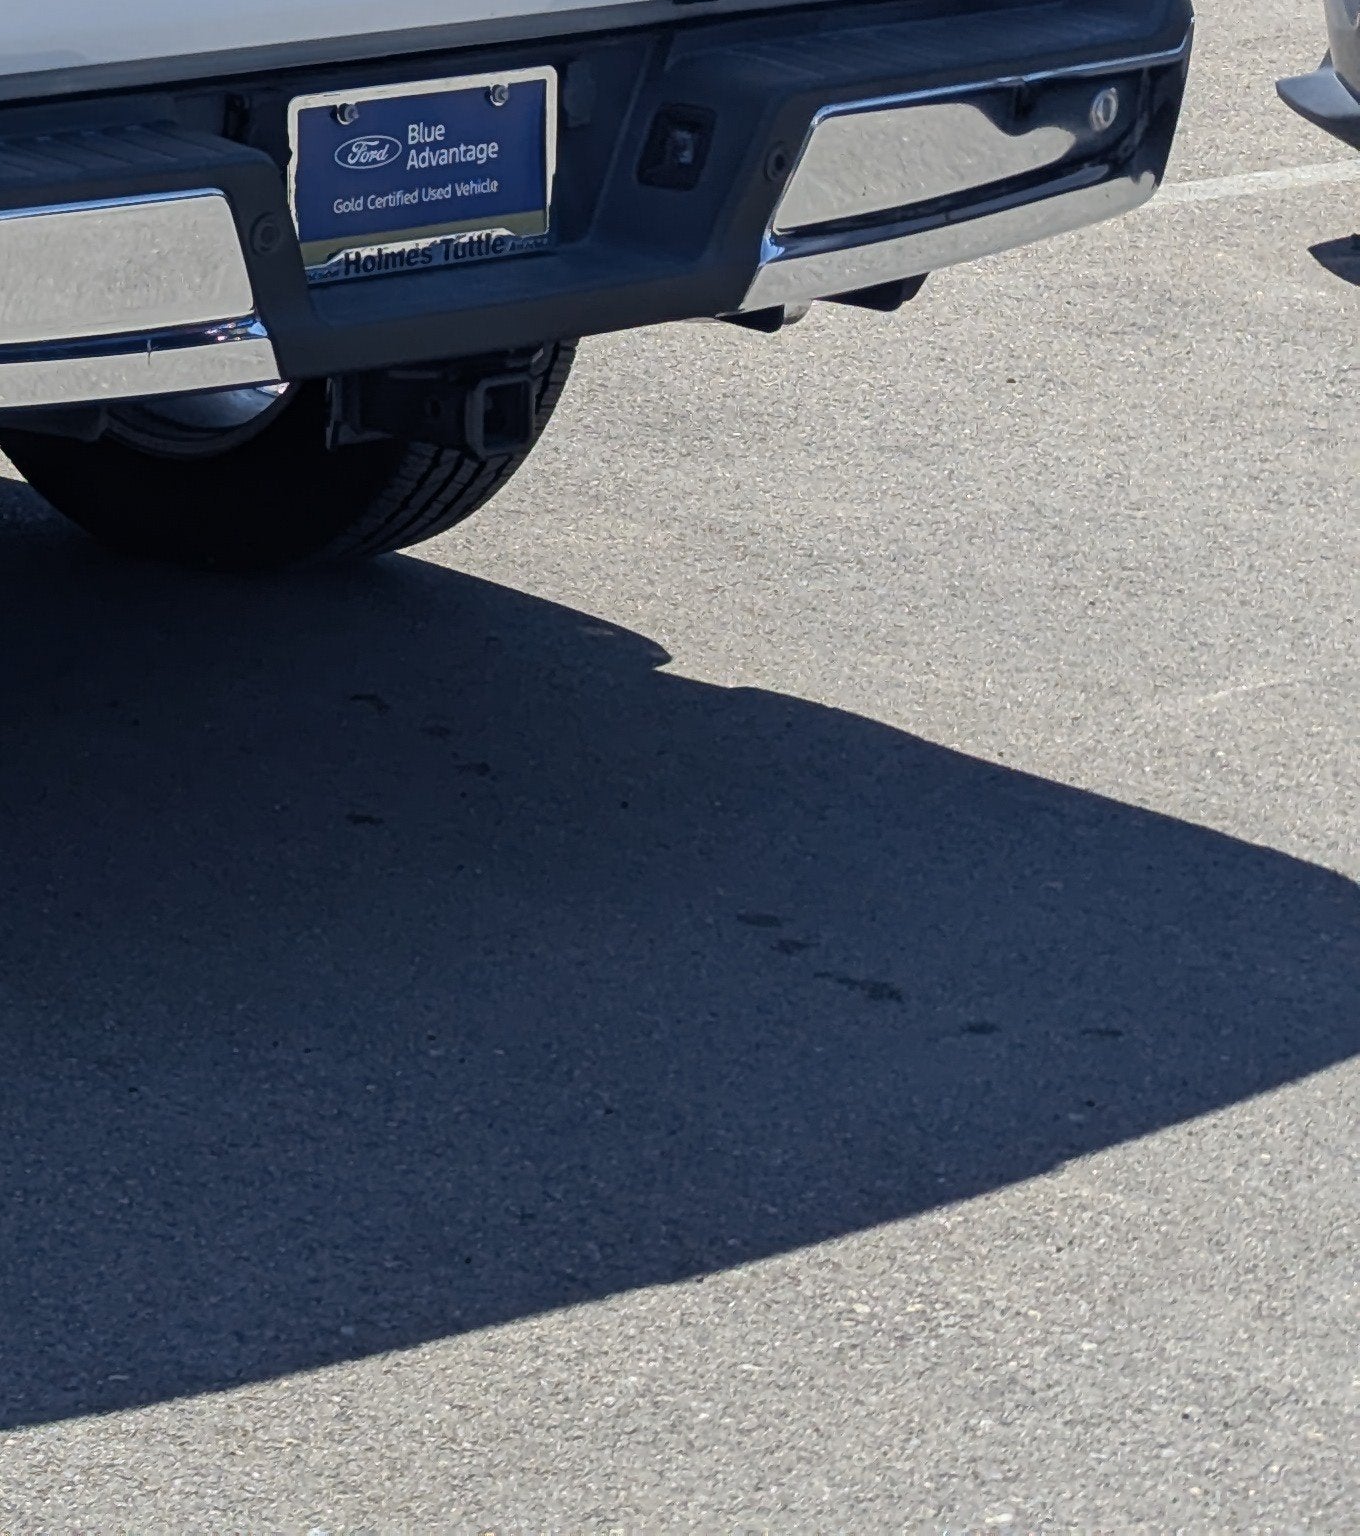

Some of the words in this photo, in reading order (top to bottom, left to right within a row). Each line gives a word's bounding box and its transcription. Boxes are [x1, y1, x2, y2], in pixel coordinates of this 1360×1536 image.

[407, 122, 446, 145] Blue
[346, 140, 390, 164] Ford
[406, 141, 499, 171] Advantage
[333, 196, 364, 214] Gold
[367, 188, 419, 209] Certified
[421, 183, 452, 201] Used
[455, 178, 499, 197] Vehicle
[343, 245, 433, 276] Holmes
[439, 232, 505, 261] Tuttle
